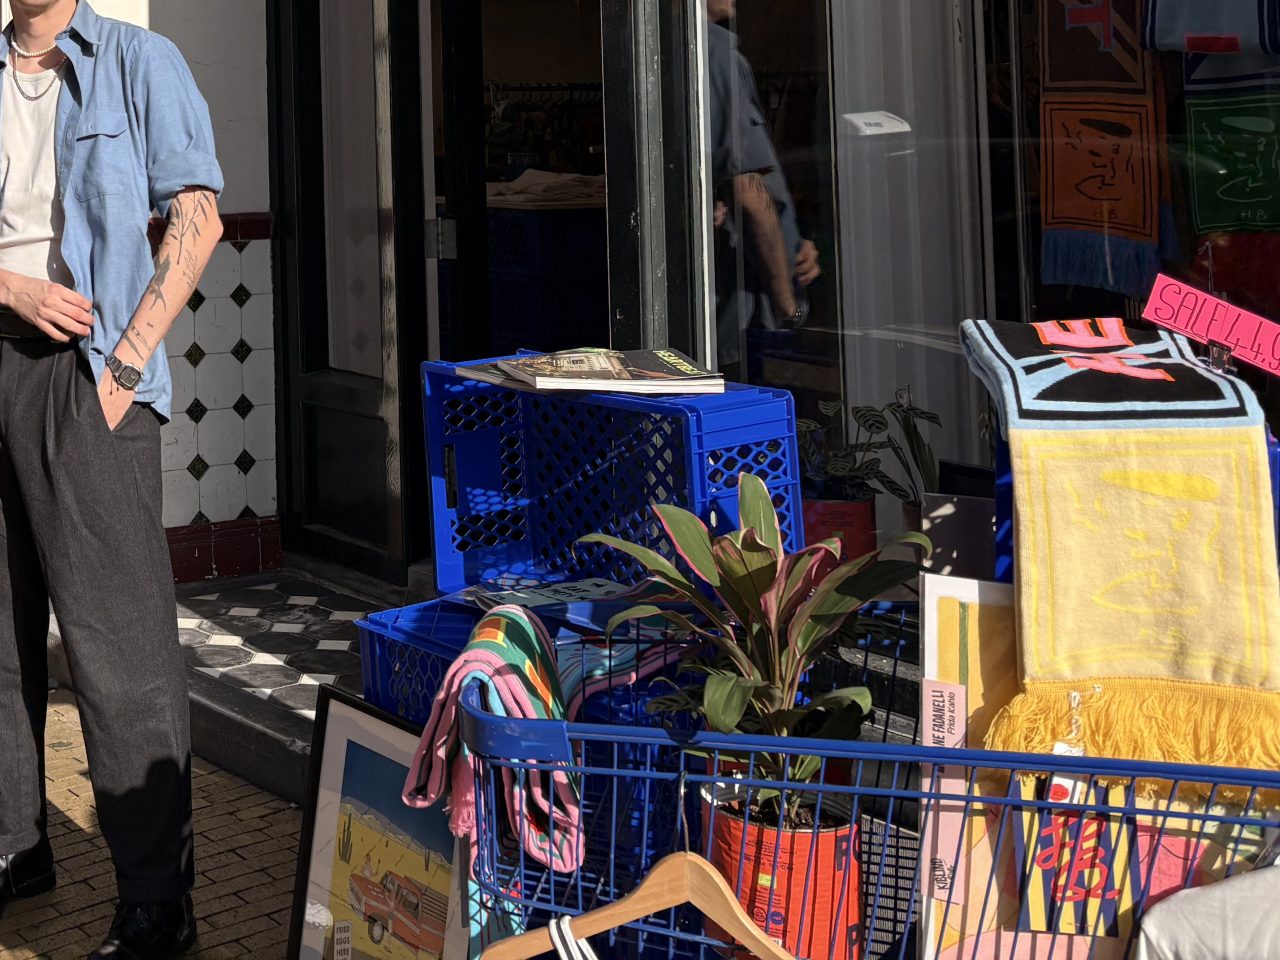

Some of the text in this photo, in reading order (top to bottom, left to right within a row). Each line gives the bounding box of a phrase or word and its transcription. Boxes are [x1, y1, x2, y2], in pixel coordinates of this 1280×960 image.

[1154, 283, 1228, 340] SALE
[931, 689, 945, 734] FADANELLI
[946, 691, 956, 736] Frida Kahlo
[930, 857, 951, 891] KIBLIND
